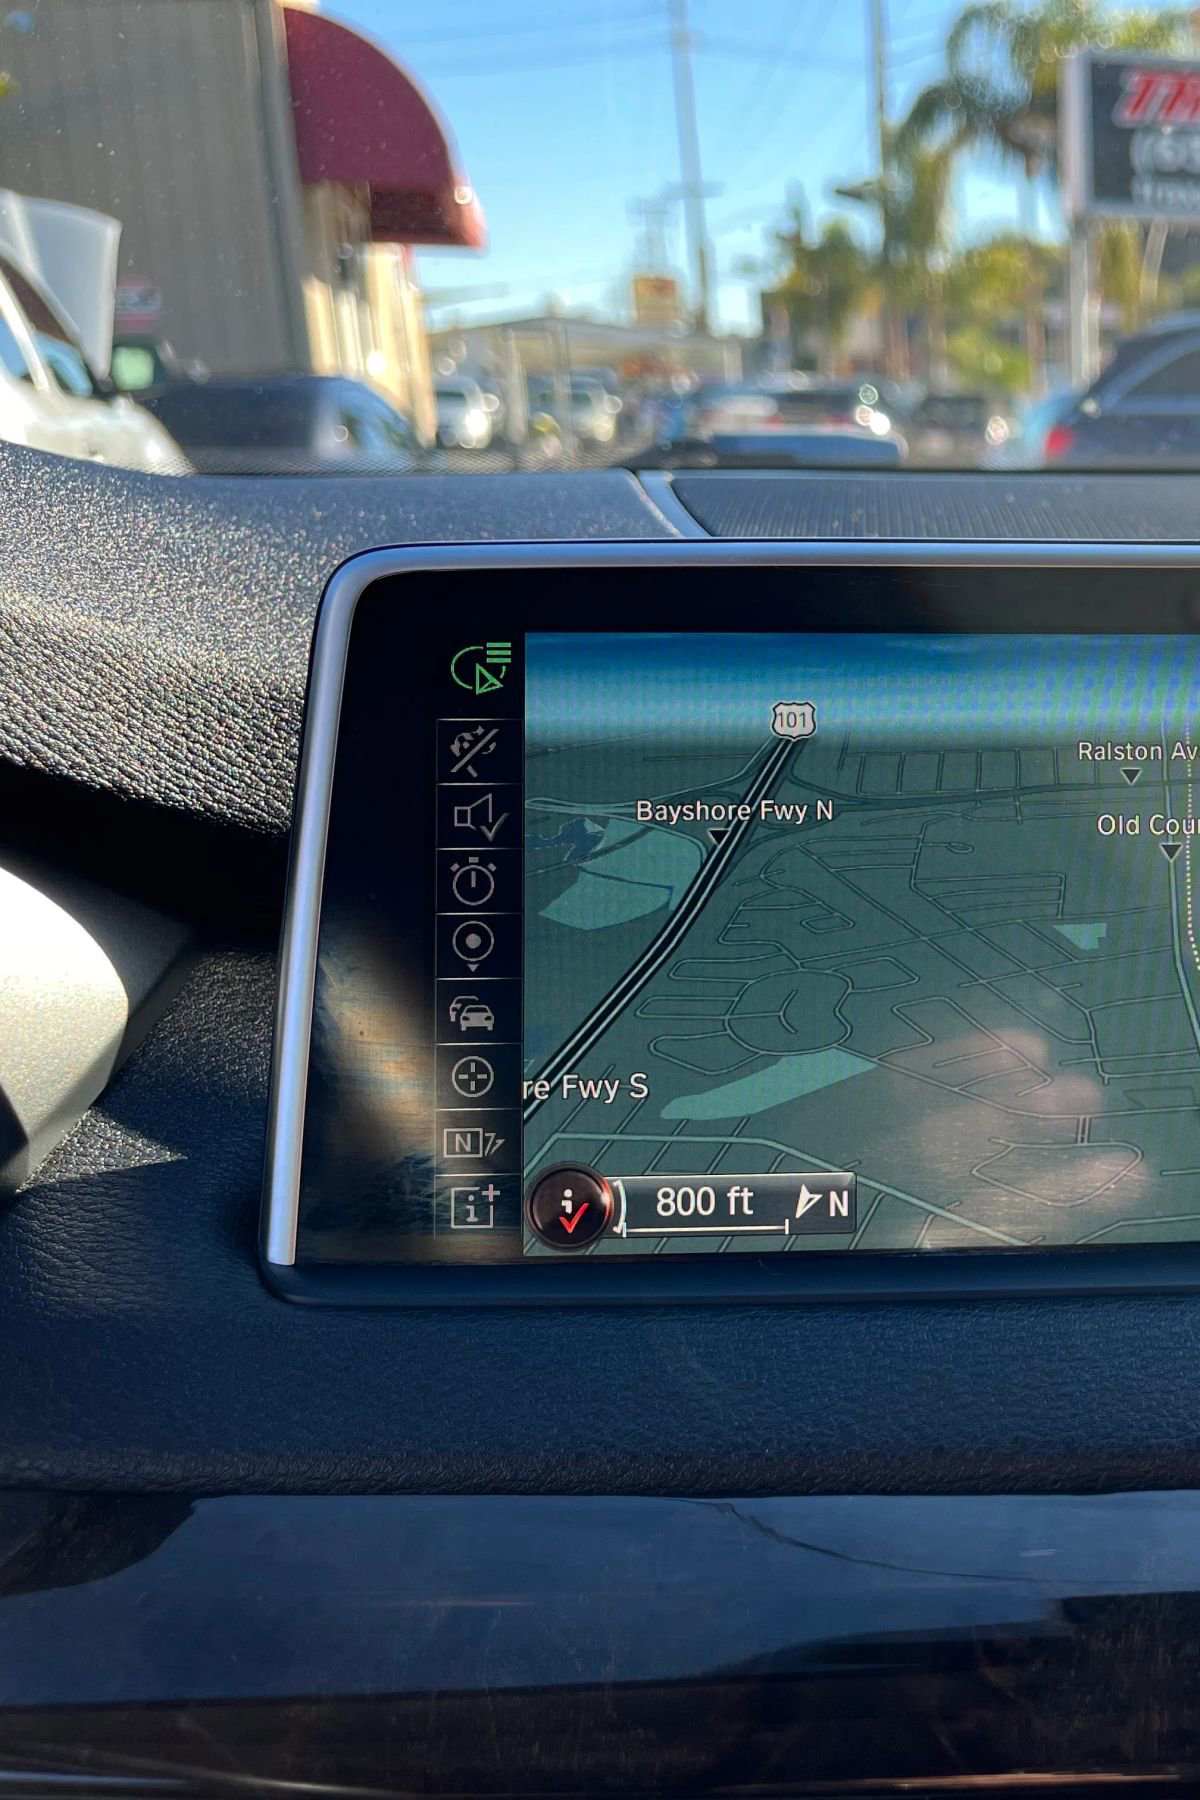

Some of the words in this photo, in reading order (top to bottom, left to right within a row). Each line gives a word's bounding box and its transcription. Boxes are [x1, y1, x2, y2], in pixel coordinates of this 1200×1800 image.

[778, 711, 807, 729] 101
[1078, 741, 1162, 760] Ralston
[637, 800, 751, 826] Bayshore
[760, 800, 808, 826] Fwy
[816, 800, 833, 820] N
[1097, 814, 1140, 835] Old
[562, 1074, 620, 1104] Fwy
[629, 1072, 649, 1098] S
[656, 1187, 714, 1216] 800
[727, 1186, 753, 1216] ft
[829, 1190, 849, 1216] N
